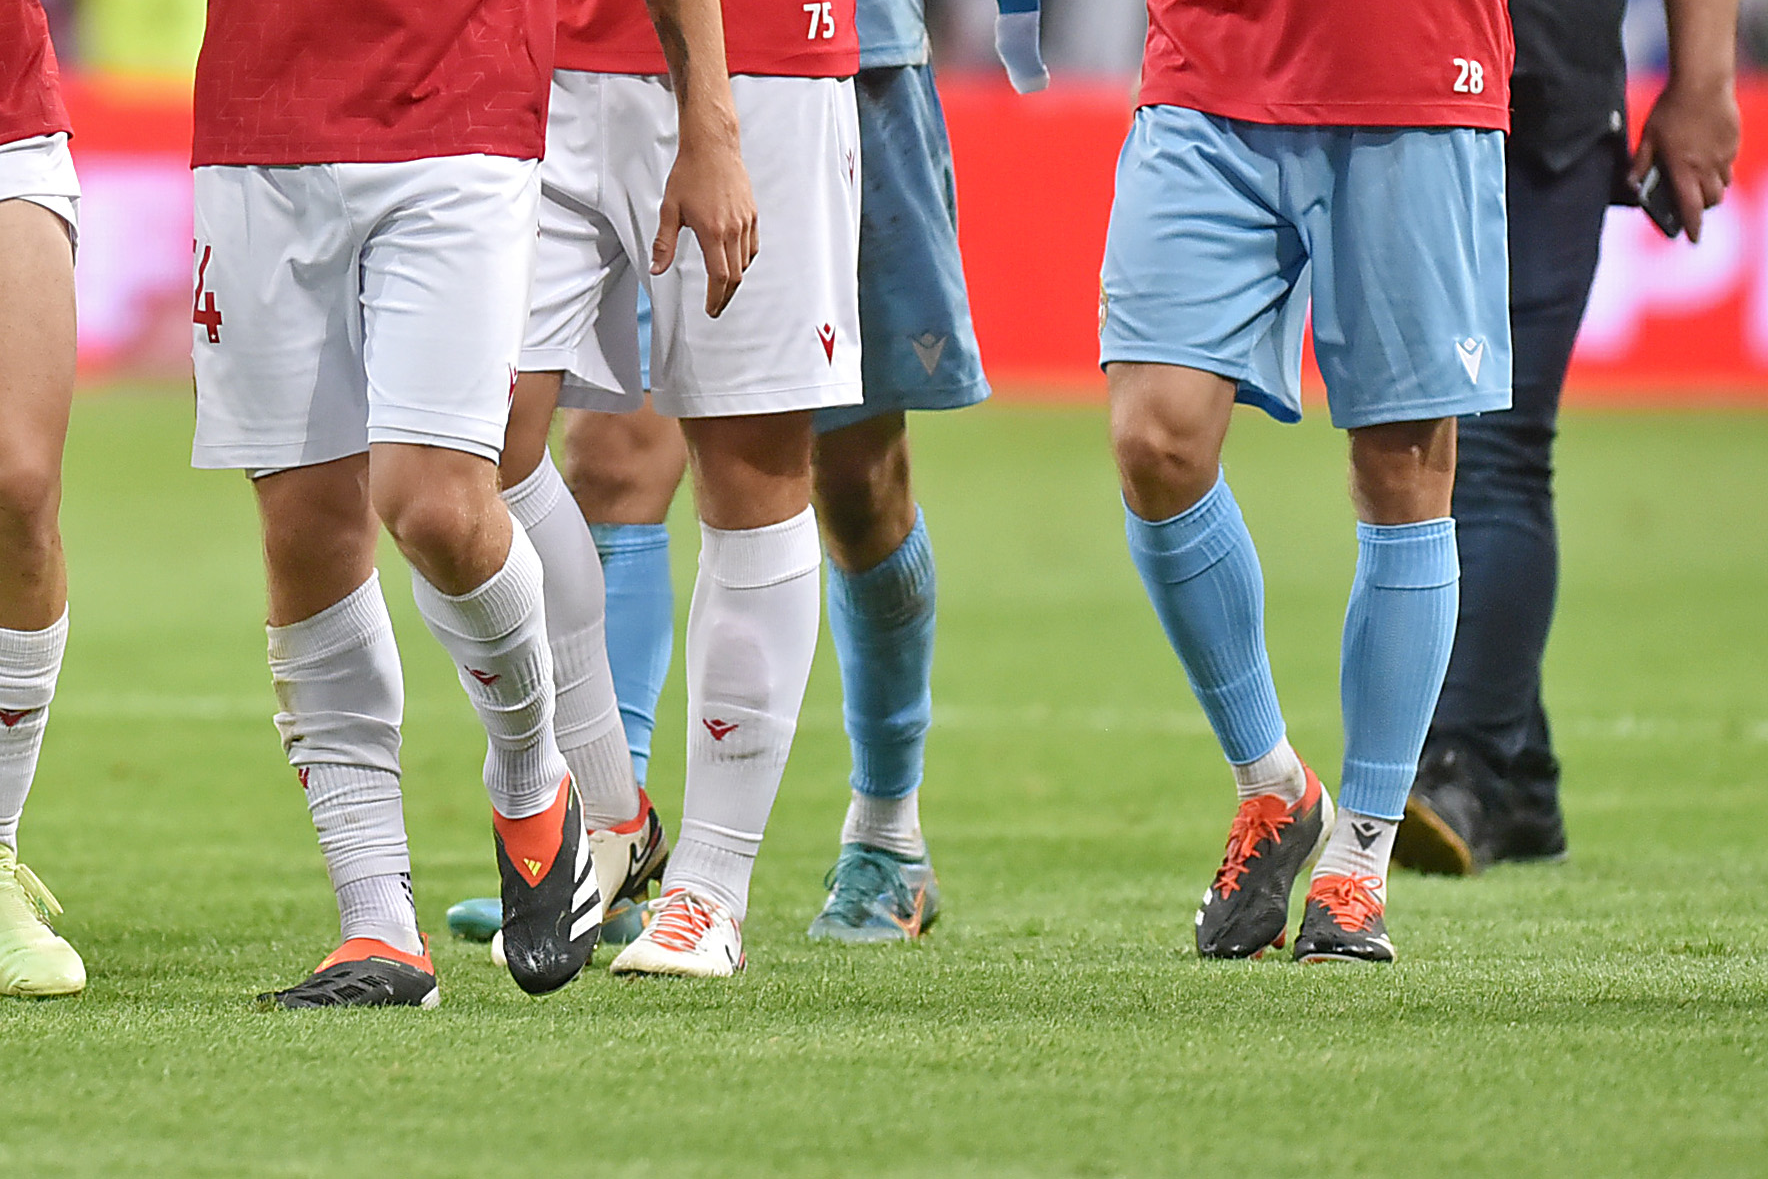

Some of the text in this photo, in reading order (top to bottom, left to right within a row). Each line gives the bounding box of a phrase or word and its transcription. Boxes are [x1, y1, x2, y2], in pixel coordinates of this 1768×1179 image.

[803, 1, 836, 40] 75
[1453, 57, 1484, 95] 28
[193, 239, 223, 344] 4
